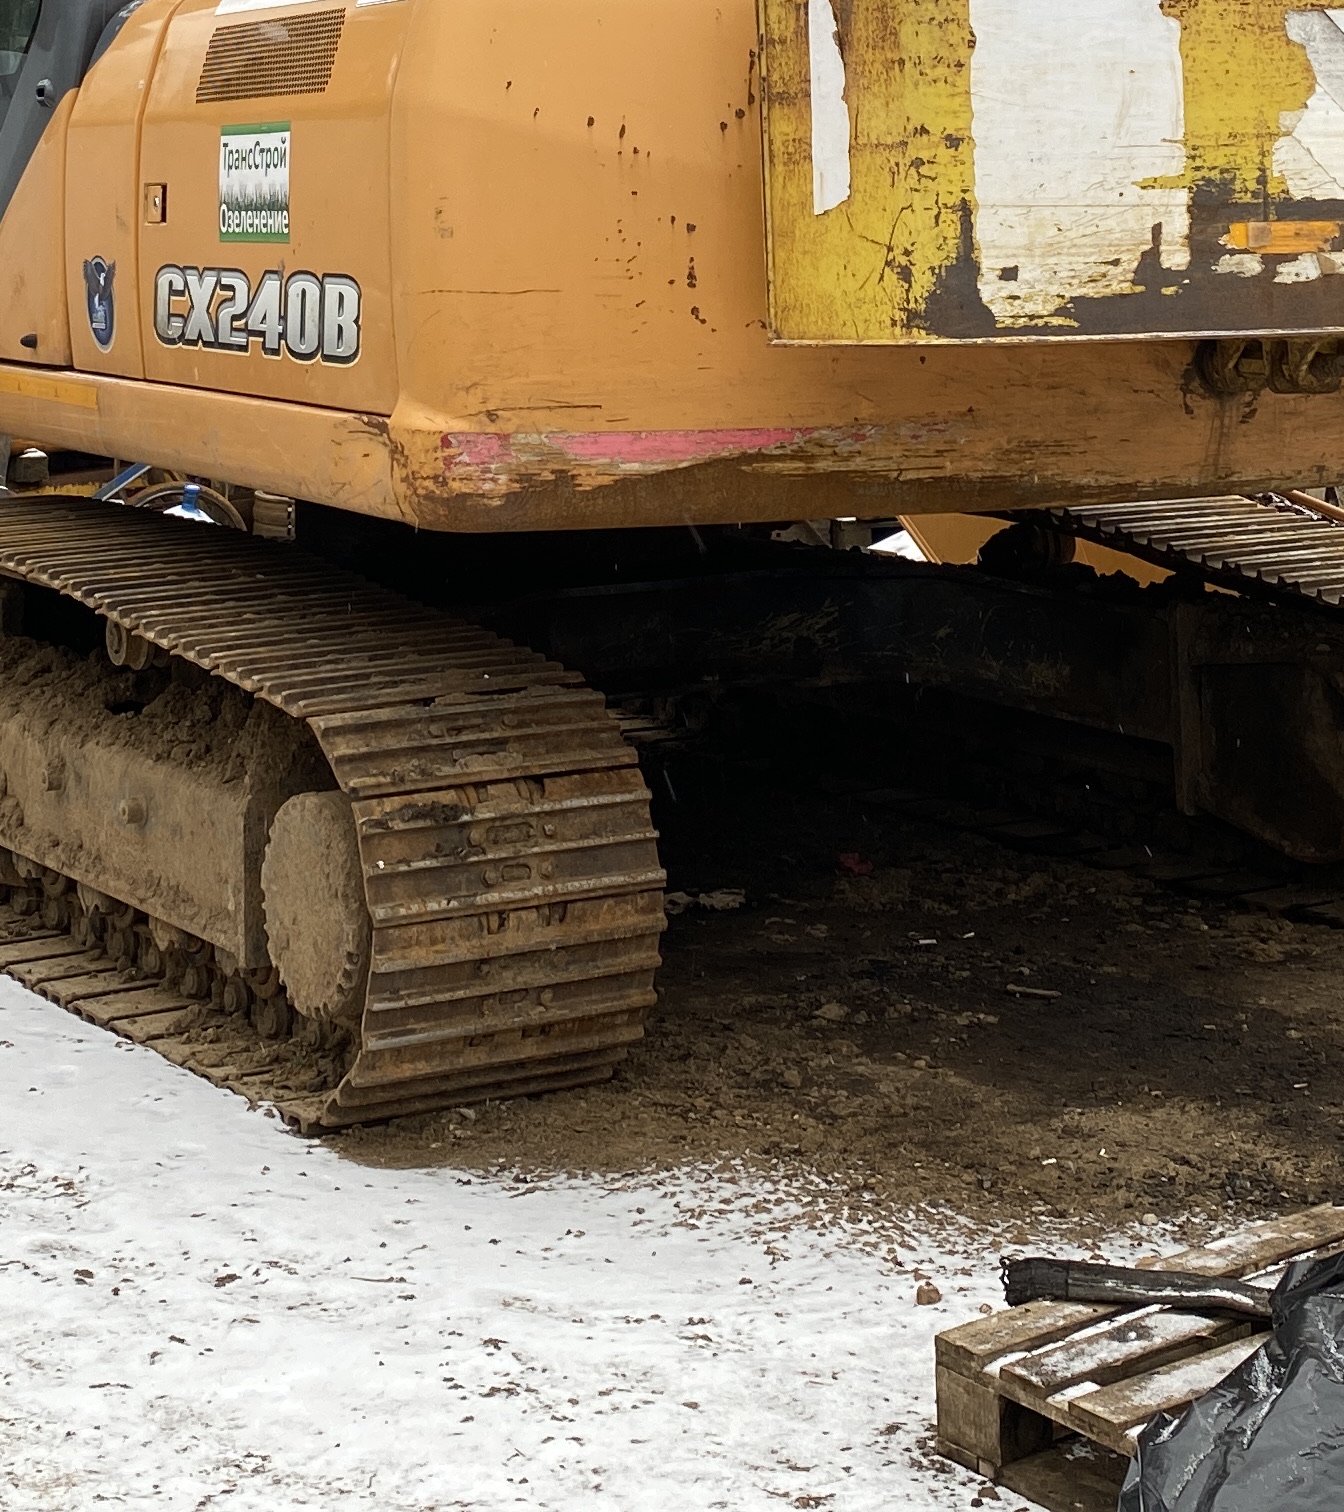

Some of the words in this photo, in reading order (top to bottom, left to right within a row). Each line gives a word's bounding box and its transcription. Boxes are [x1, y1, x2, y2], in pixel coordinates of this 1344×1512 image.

[222, 136, 287, 178] ТрансСтрой
[219, 203, 289, 234] Озеленение
[155, 265, 362, 366] CX240B
